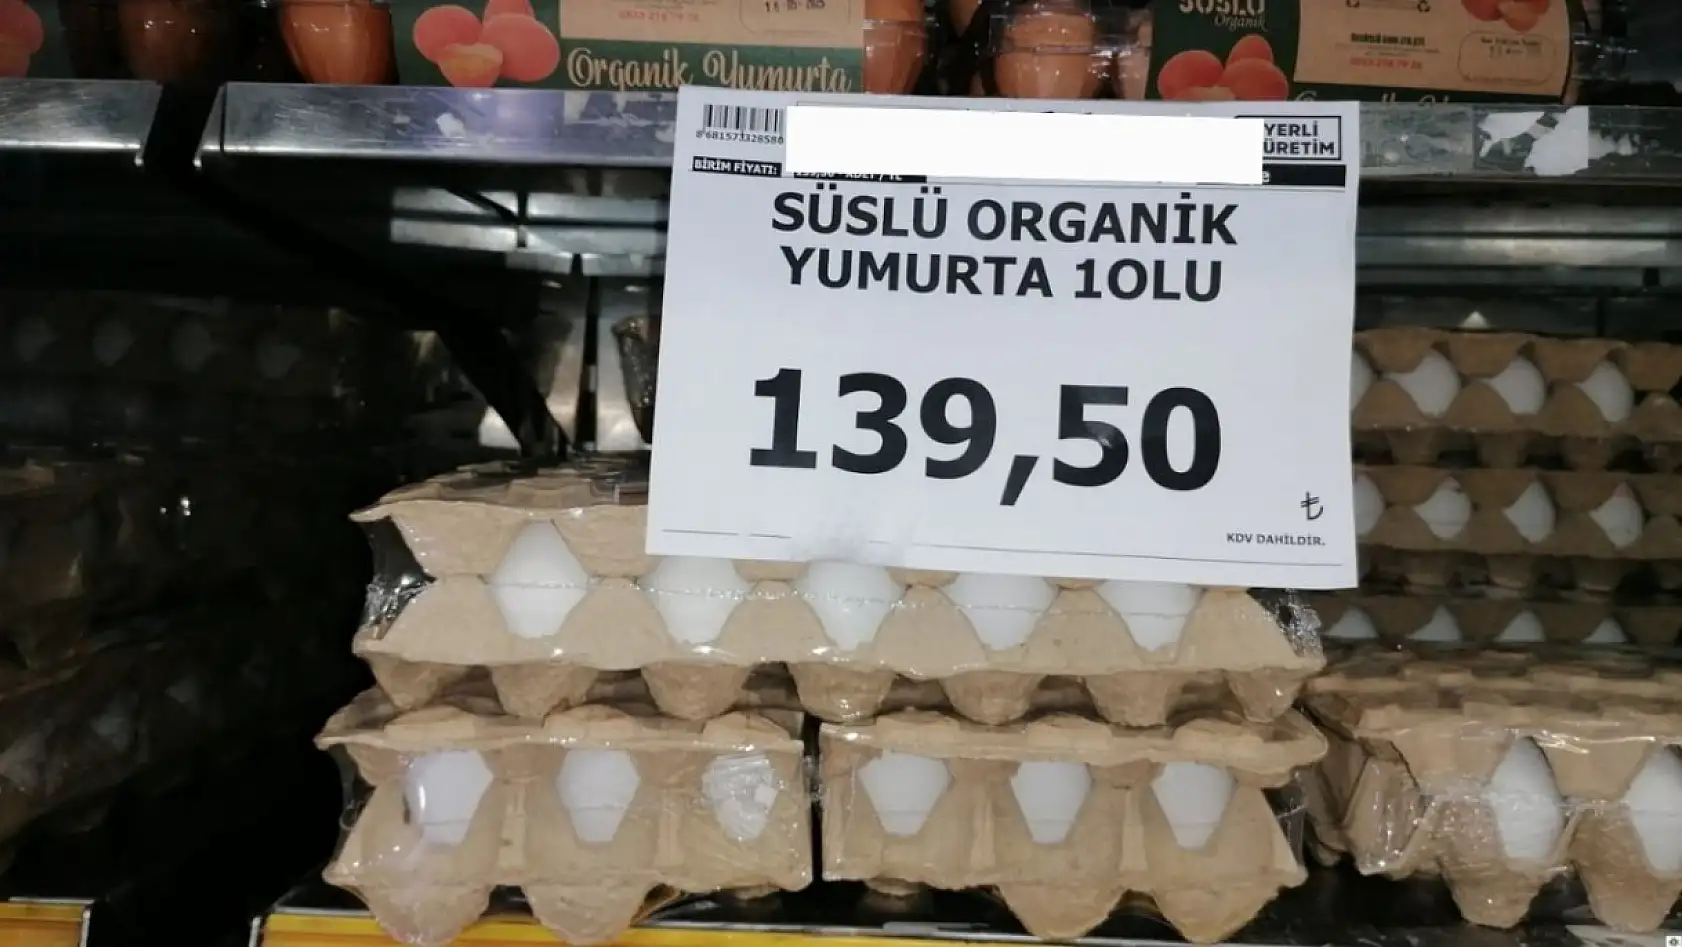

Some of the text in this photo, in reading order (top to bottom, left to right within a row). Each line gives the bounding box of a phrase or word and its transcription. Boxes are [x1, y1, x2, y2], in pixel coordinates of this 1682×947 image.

[1214, 14, 1268, 32] Organik
[567, 48, 851, 92] Organik Yumurta
[1264, 120, 1318, 137] YERLİ
[1263, 138, 1335, 155] ÜRETİM
[694, 157, 777, 175] BİRİM FİYATI:
[772, 183, 1238, 245] SÜSLÜ ORGANİK
[780, 245, 1053, 298] YUMURTA
[750, 368, 1221, 506] 139,50
[1226, 532, 1326, 546] KDV DAHİLDİR.
